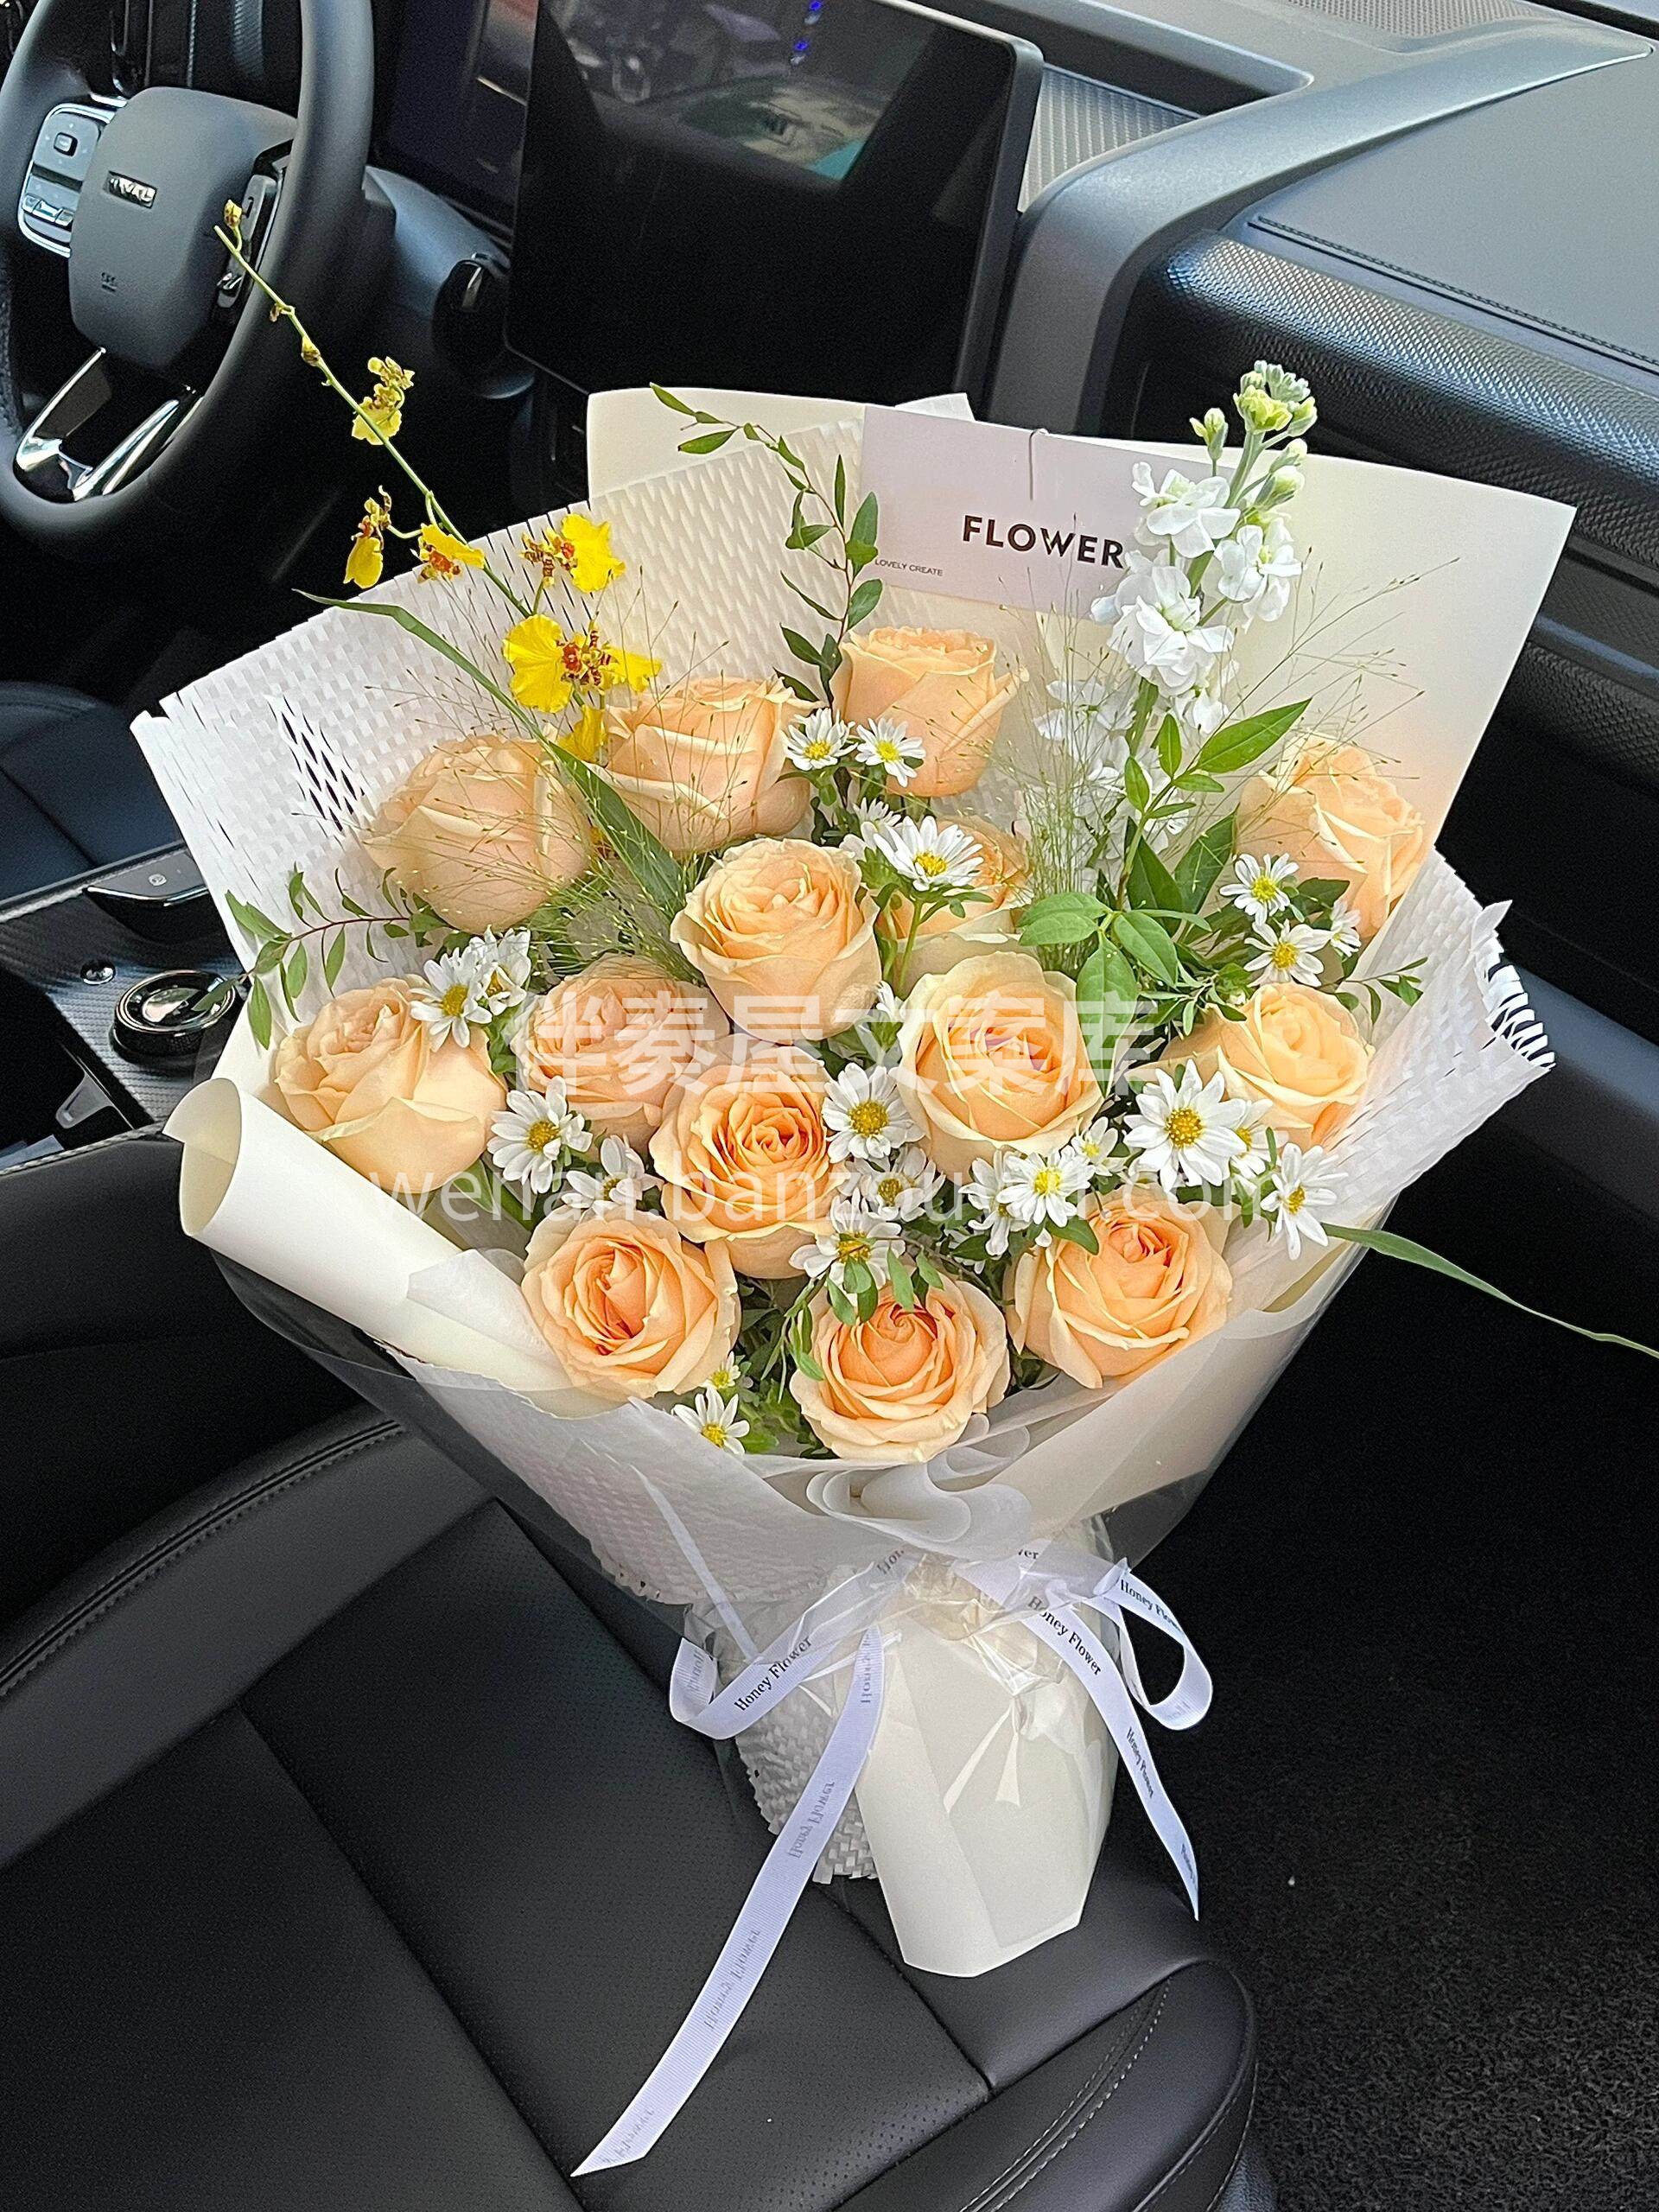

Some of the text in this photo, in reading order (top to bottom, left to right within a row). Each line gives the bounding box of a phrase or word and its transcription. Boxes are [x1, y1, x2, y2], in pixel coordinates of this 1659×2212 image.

[874, 558, 944, 577] LOVELY CREATE
[962, 514, 1124, 569] FLOWER
[1120, 1578, 1154, 1611] Honey
[1027, 1595, 1102, 1675] Honey Flower
[734, 1636, 813, 1713] Honey Flower
